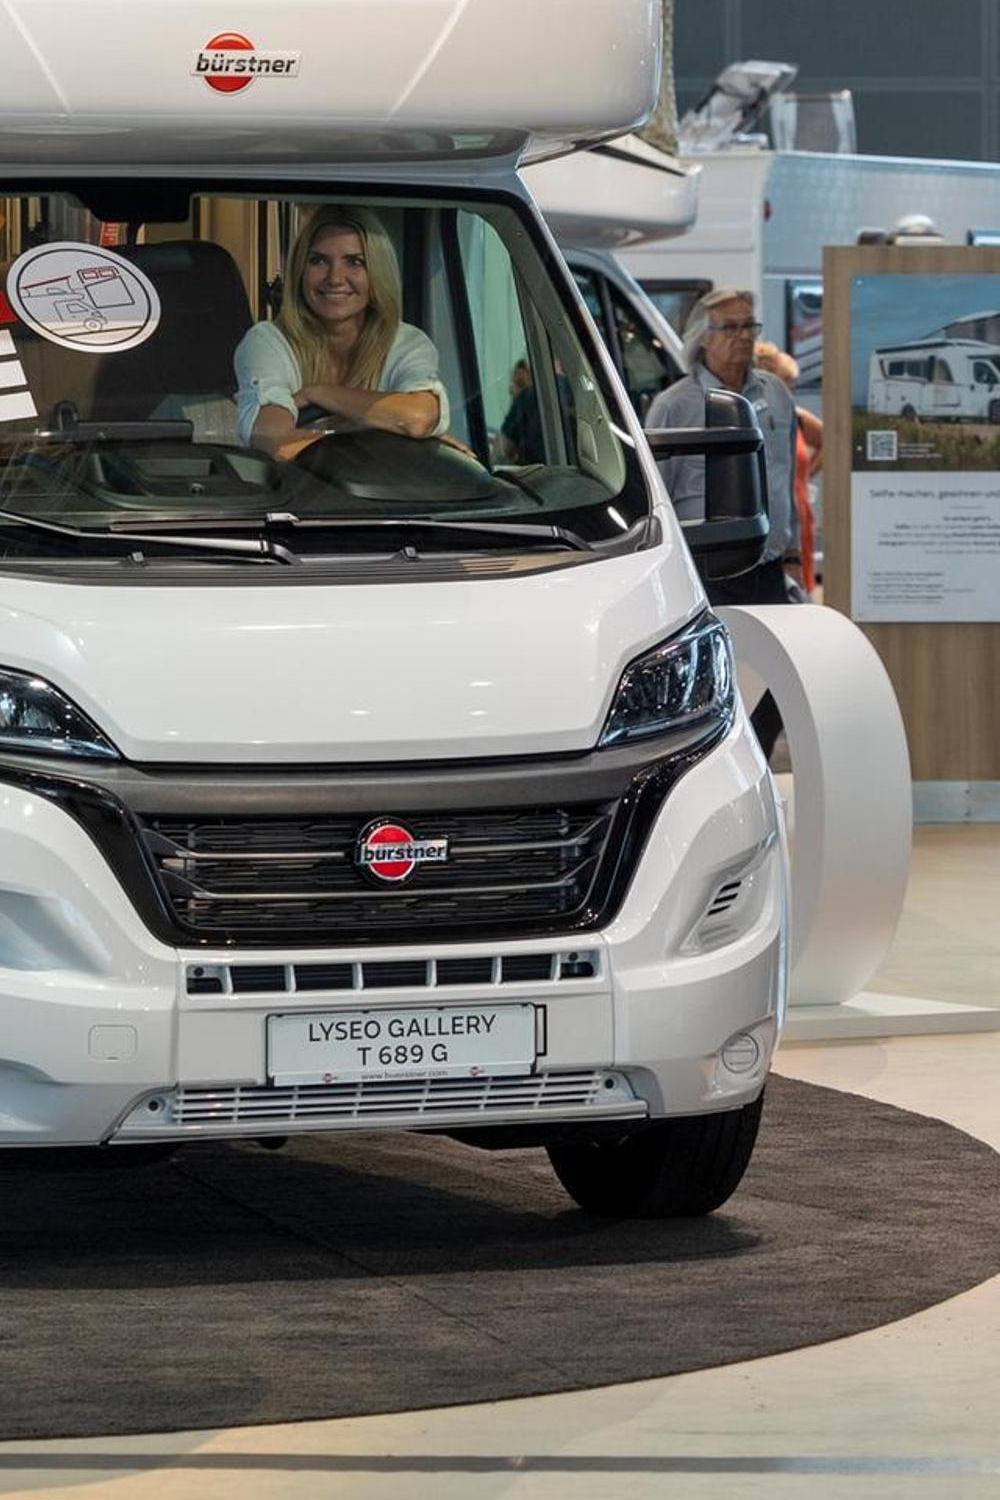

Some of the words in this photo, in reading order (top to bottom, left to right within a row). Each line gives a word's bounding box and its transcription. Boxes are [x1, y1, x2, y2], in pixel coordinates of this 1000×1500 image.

[196, 52, 297, 74] bürstner
[308, 1020, 382, 1043] LYSEO
[387, 1014, 497, 1038] GALLERY
[357, 1047, 372, 1067] T
[377, 1044, 424, 1065] 689
[430, 1043, 449, 1063] G
